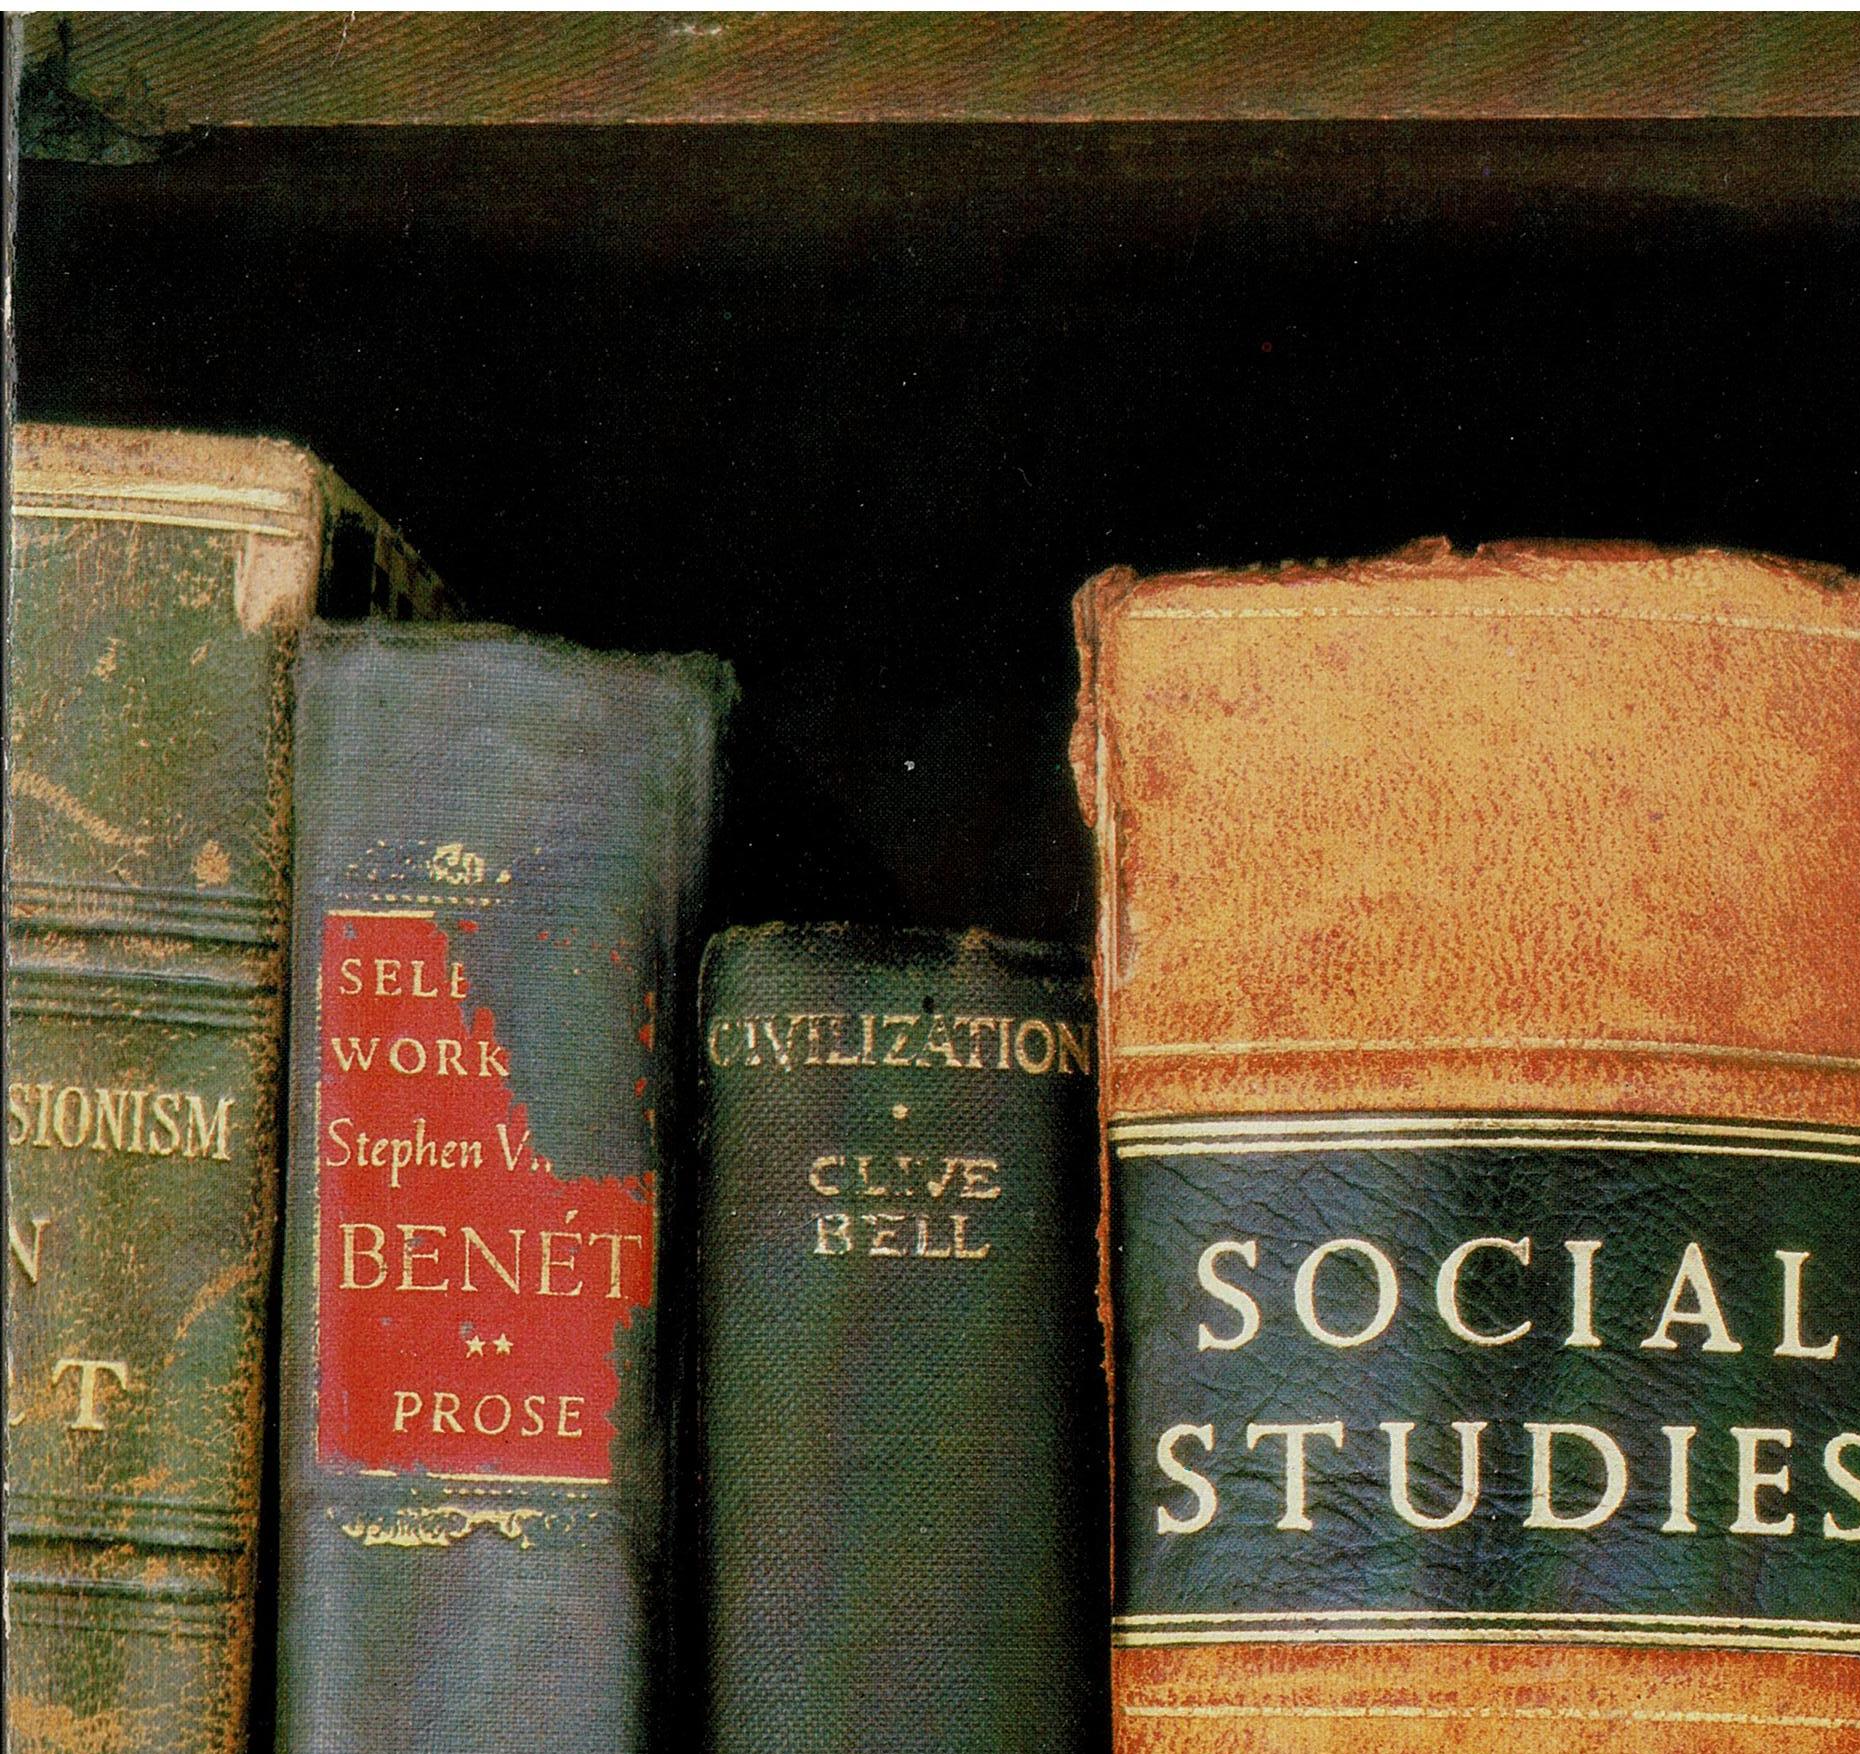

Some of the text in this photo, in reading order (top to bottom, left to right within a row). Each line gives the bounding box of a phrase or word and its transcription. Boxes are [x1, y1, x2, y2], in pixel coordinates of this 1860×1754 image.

[331, 1037, 510, 1077] WORK
[708, 1013, 1091, 1075] CIVILIZATION
[8, 1083, 235, 1161] SIONISM
[326, 1117, 483, 1188] Stephen
[339, 1210, 643, 1300] BENÉT
[812, 1211, 991, 1259] BELL
[1198, 1236, 1839, 1360] SOCIAL
[392, 1391, 584, 1437] PROSE
